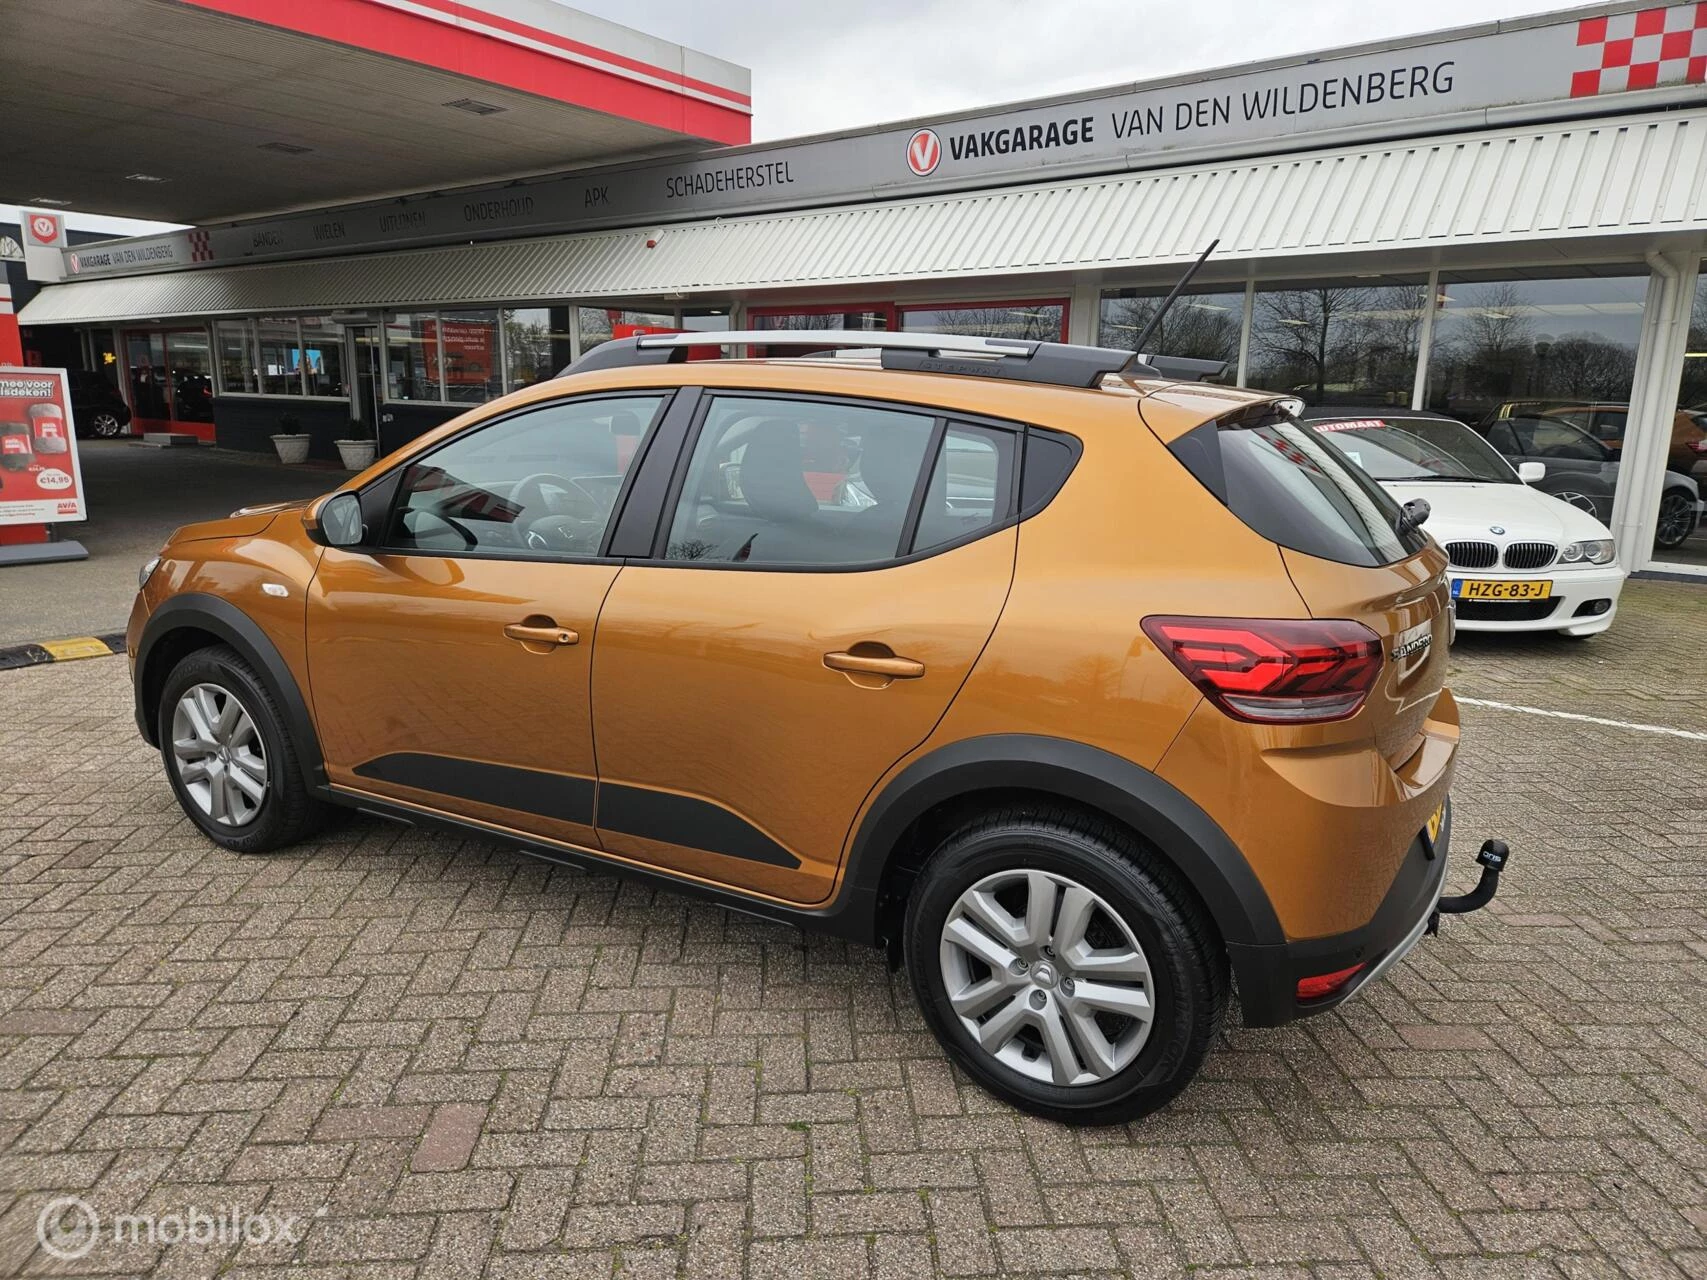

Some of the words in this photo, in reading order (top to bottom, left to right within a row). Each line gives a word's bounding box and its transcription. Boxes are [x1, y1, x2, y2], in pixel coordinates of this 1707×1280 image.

[950, 116, 1094, 161] VAKGARAGE
[1111, 105, 1163, 139] VAN
[1175, 97, 1230, 131] DEN
[1242, 61, 1455, 121] WILDENBERG
[665, 161, 794, 198] SCHADEHERSTEL
[584, 186, 609, 208] APK
[463, 196, 534, 222] ONDERHOUD
[312, 221, 346, 240] WIELEN
[80, 254, 111, 268] VAKGARAGE
[112, 251, 124, 264] VAN
[125, 249, 136, 262] DEN
[136, 245, 173, 261] WILDENBERG
[26, 380, 53, 388] voor
[1468, 583, 1544, 597] HZG-83-J
[1391, 633, 1433, 662] SANDERO
